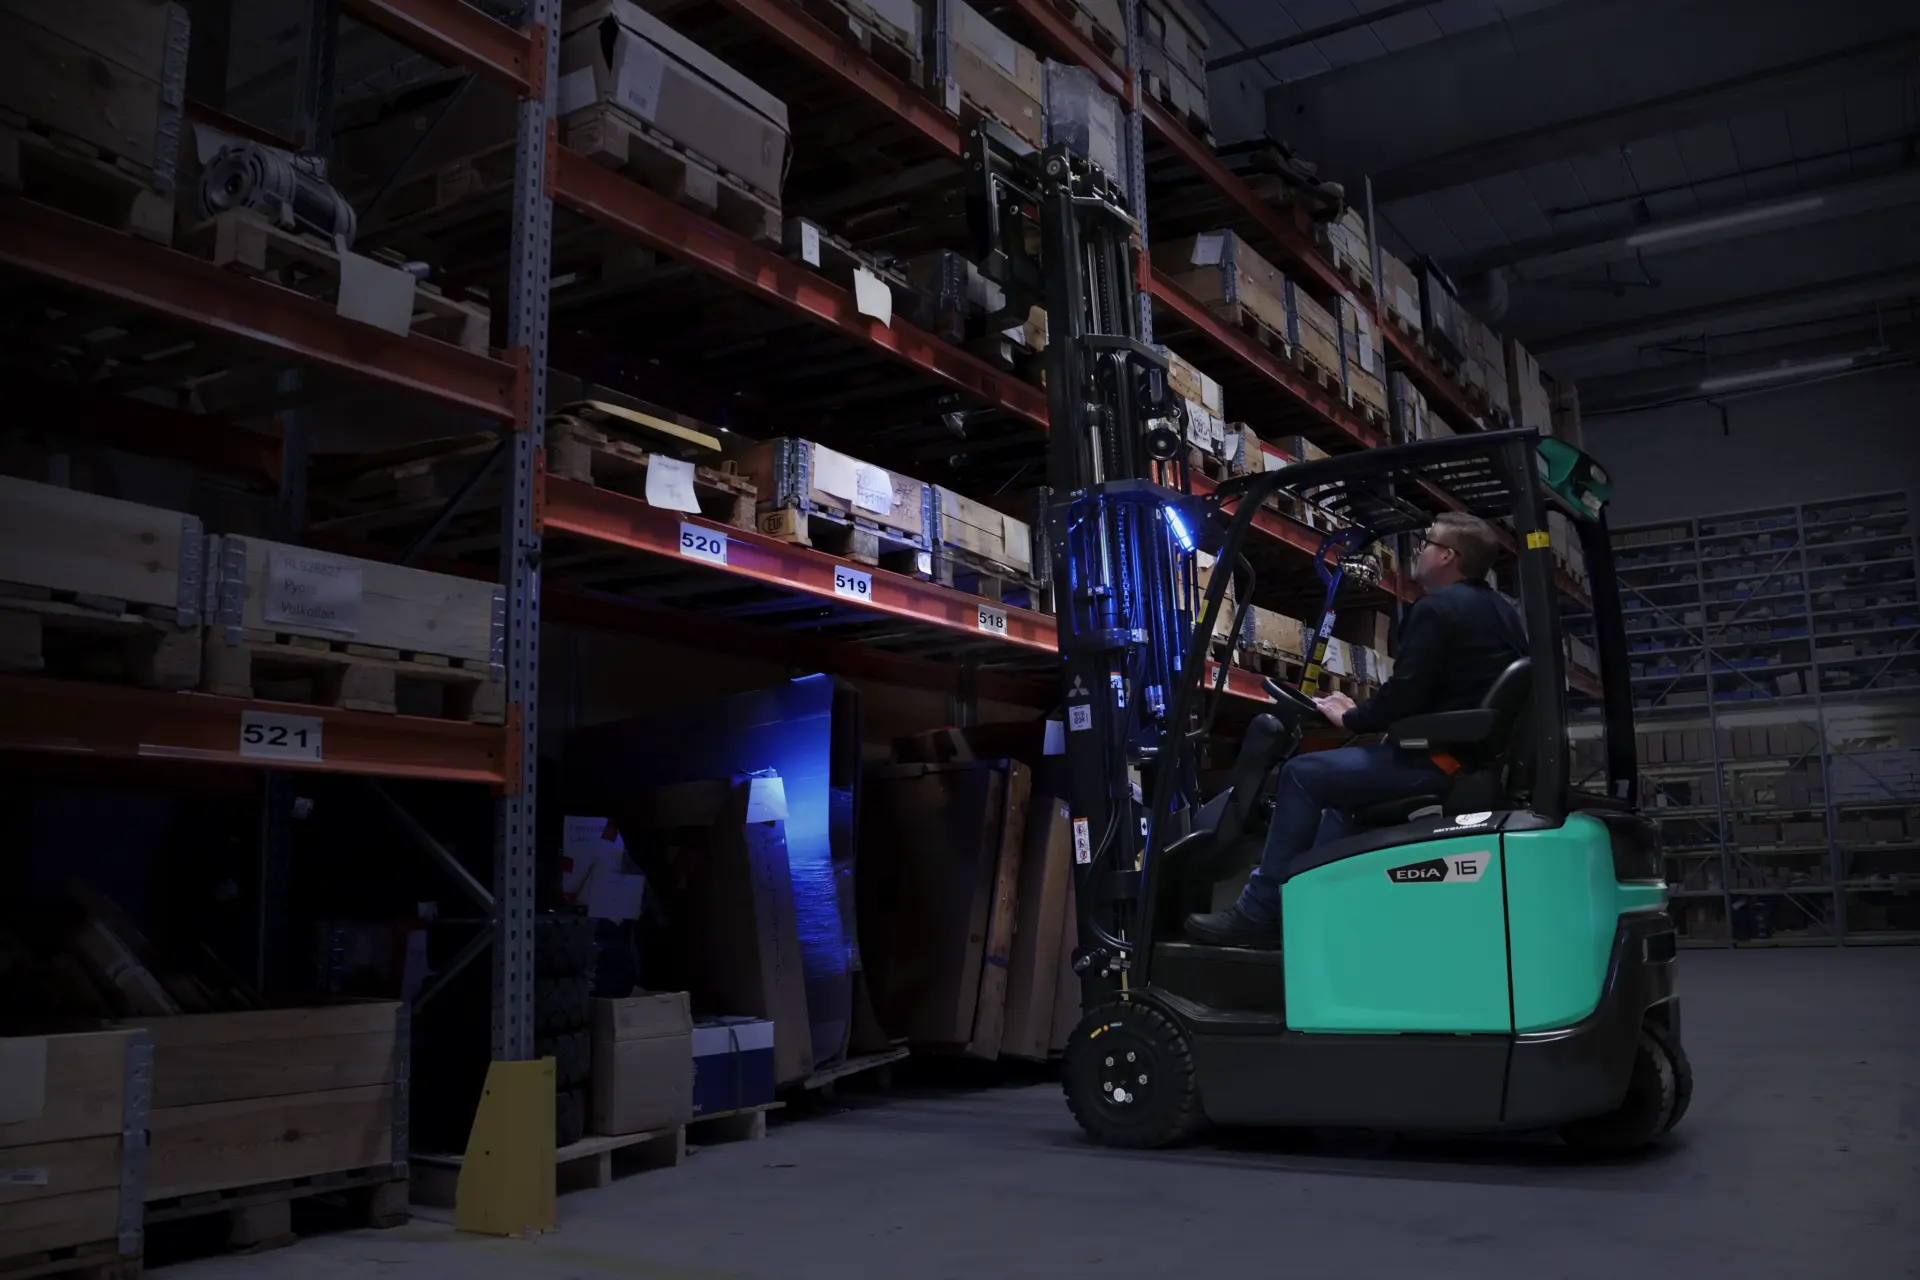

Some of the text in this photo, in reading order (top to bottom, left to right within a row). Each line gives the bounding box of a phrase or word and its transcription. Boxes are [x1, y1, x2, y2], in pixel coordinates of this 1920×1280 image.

[682, 532, 721, 555] 520
[836, 574, 867, 594] 519
[979, 612, 1004, 629] 518
[243, 724, 307, 748] 521
[1454, 860, 1477, 875] 16
